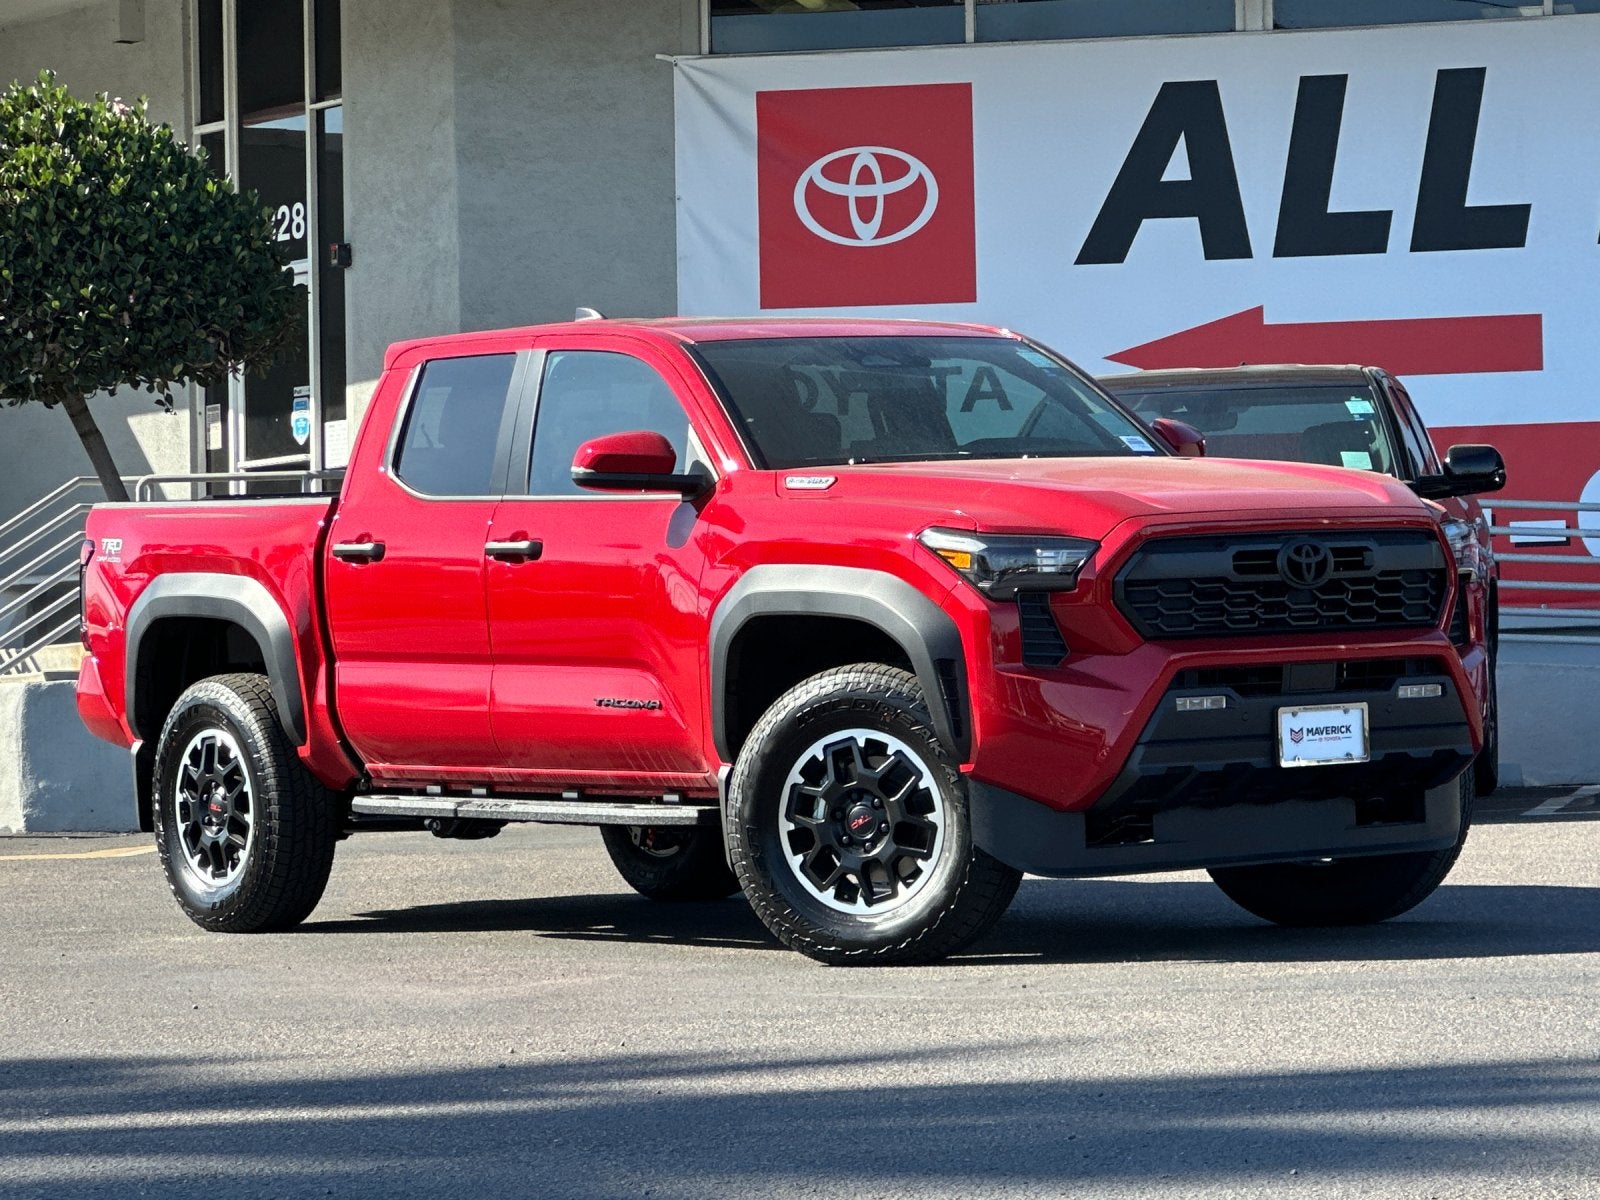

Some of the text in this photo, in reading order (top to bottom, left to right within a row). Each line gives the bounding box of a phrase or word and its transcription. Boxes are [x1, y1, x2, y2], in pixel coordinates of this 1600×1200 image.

[1073, 66, 1532, 266] ALL
[270, 202, 305, 242] 28
[594, 698, 663, 710] TACOMA
[1306, 724, 1352, 737] MAVERICK
